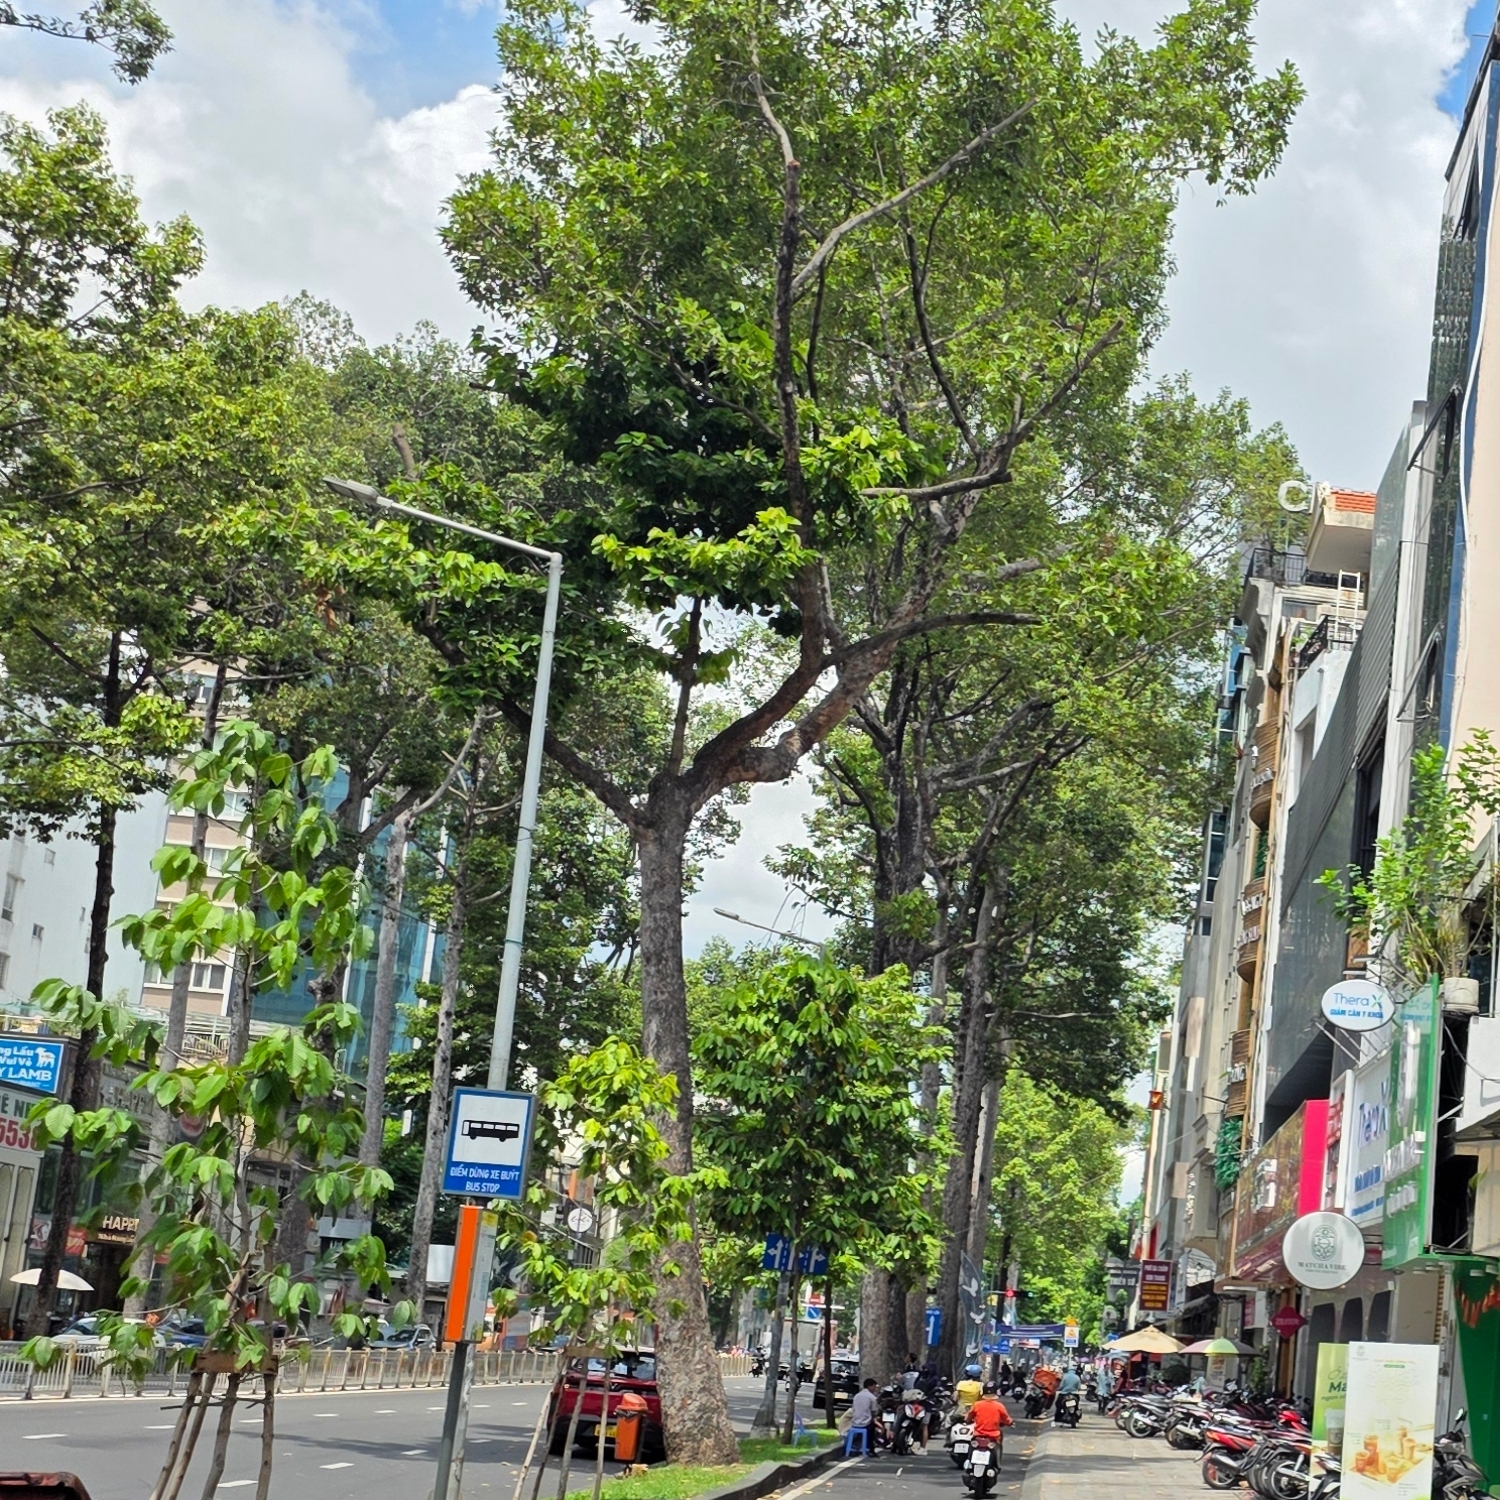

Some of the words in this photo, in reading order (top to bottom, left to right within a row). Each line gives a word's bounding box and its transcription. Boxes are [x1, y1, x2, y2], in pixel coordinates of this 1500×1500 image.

[1333, 992, 1369, 1007] Thera
[8, 1068, 52, 1081] LAMB
[490, 1169, 500, 1180] XE
[466, 1181, 480, 1191] BUS
[481, 1182, 501, 1193] STOP
[1298, 1261, 1329, 1270] MATCHA
